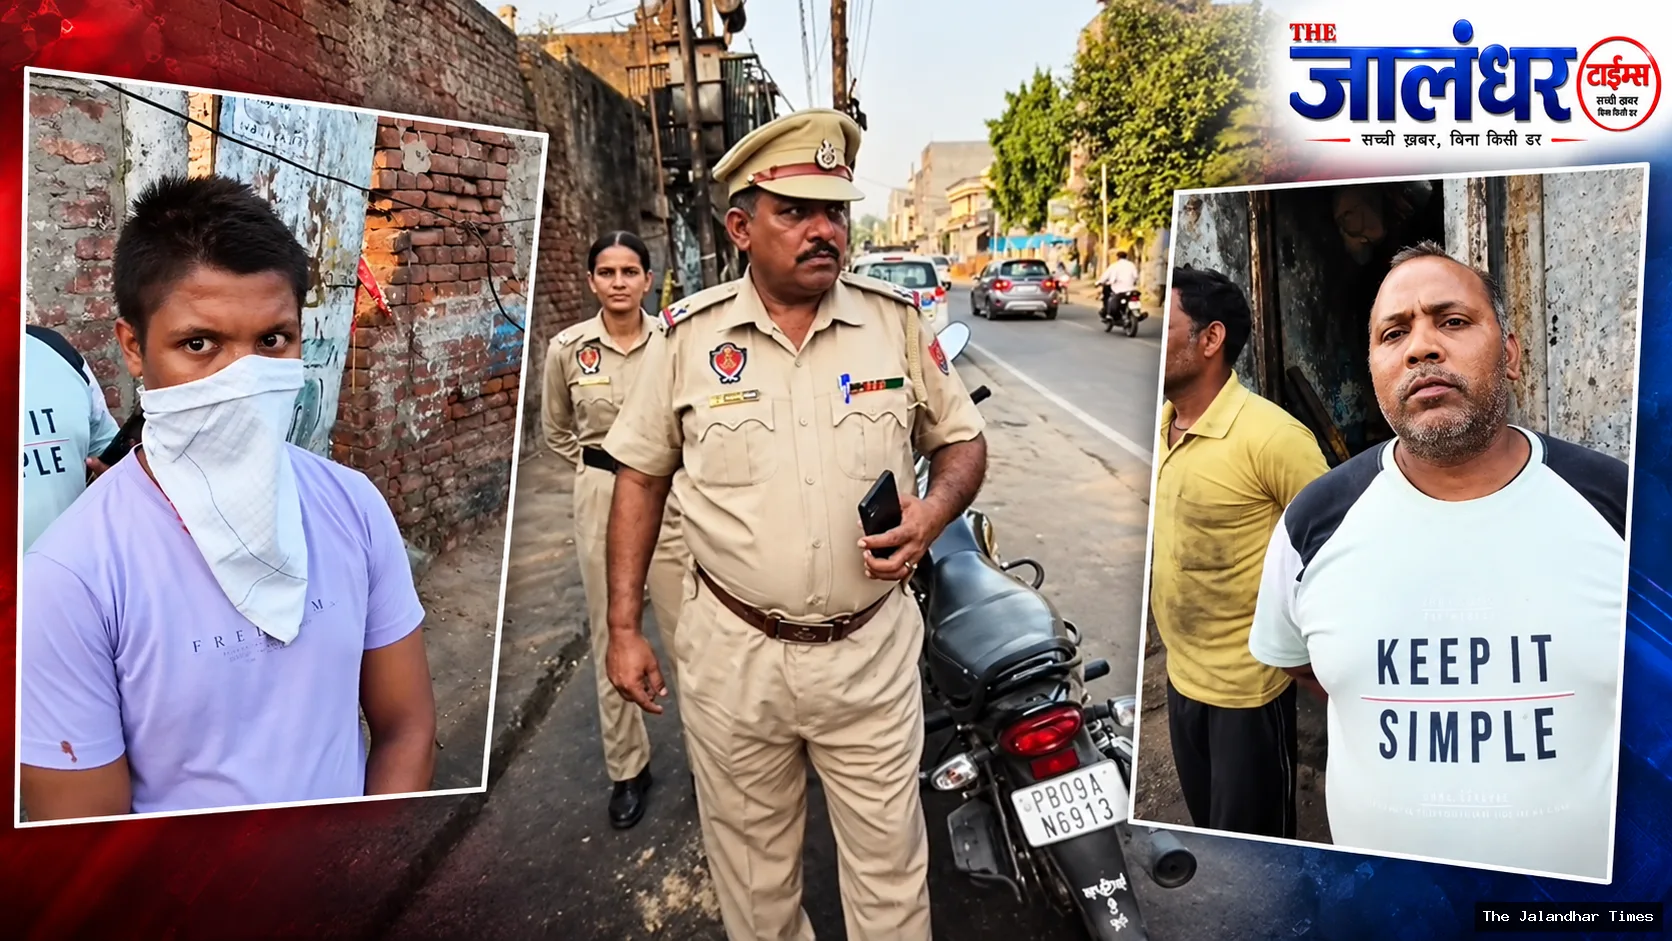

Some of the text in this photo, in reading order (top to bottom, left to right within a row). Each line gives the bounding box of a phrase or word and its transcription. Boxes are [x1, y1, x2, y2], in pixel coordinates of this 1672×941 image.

[29, 408, 56, 435] IT
[1378, 634, 1552, 685] KEEP IT
[1378, 707, 1557, 763] SIMPLE
[1031, 773, 1104, 813] PB09A
[1041, 798, 1114, 838] N6913
